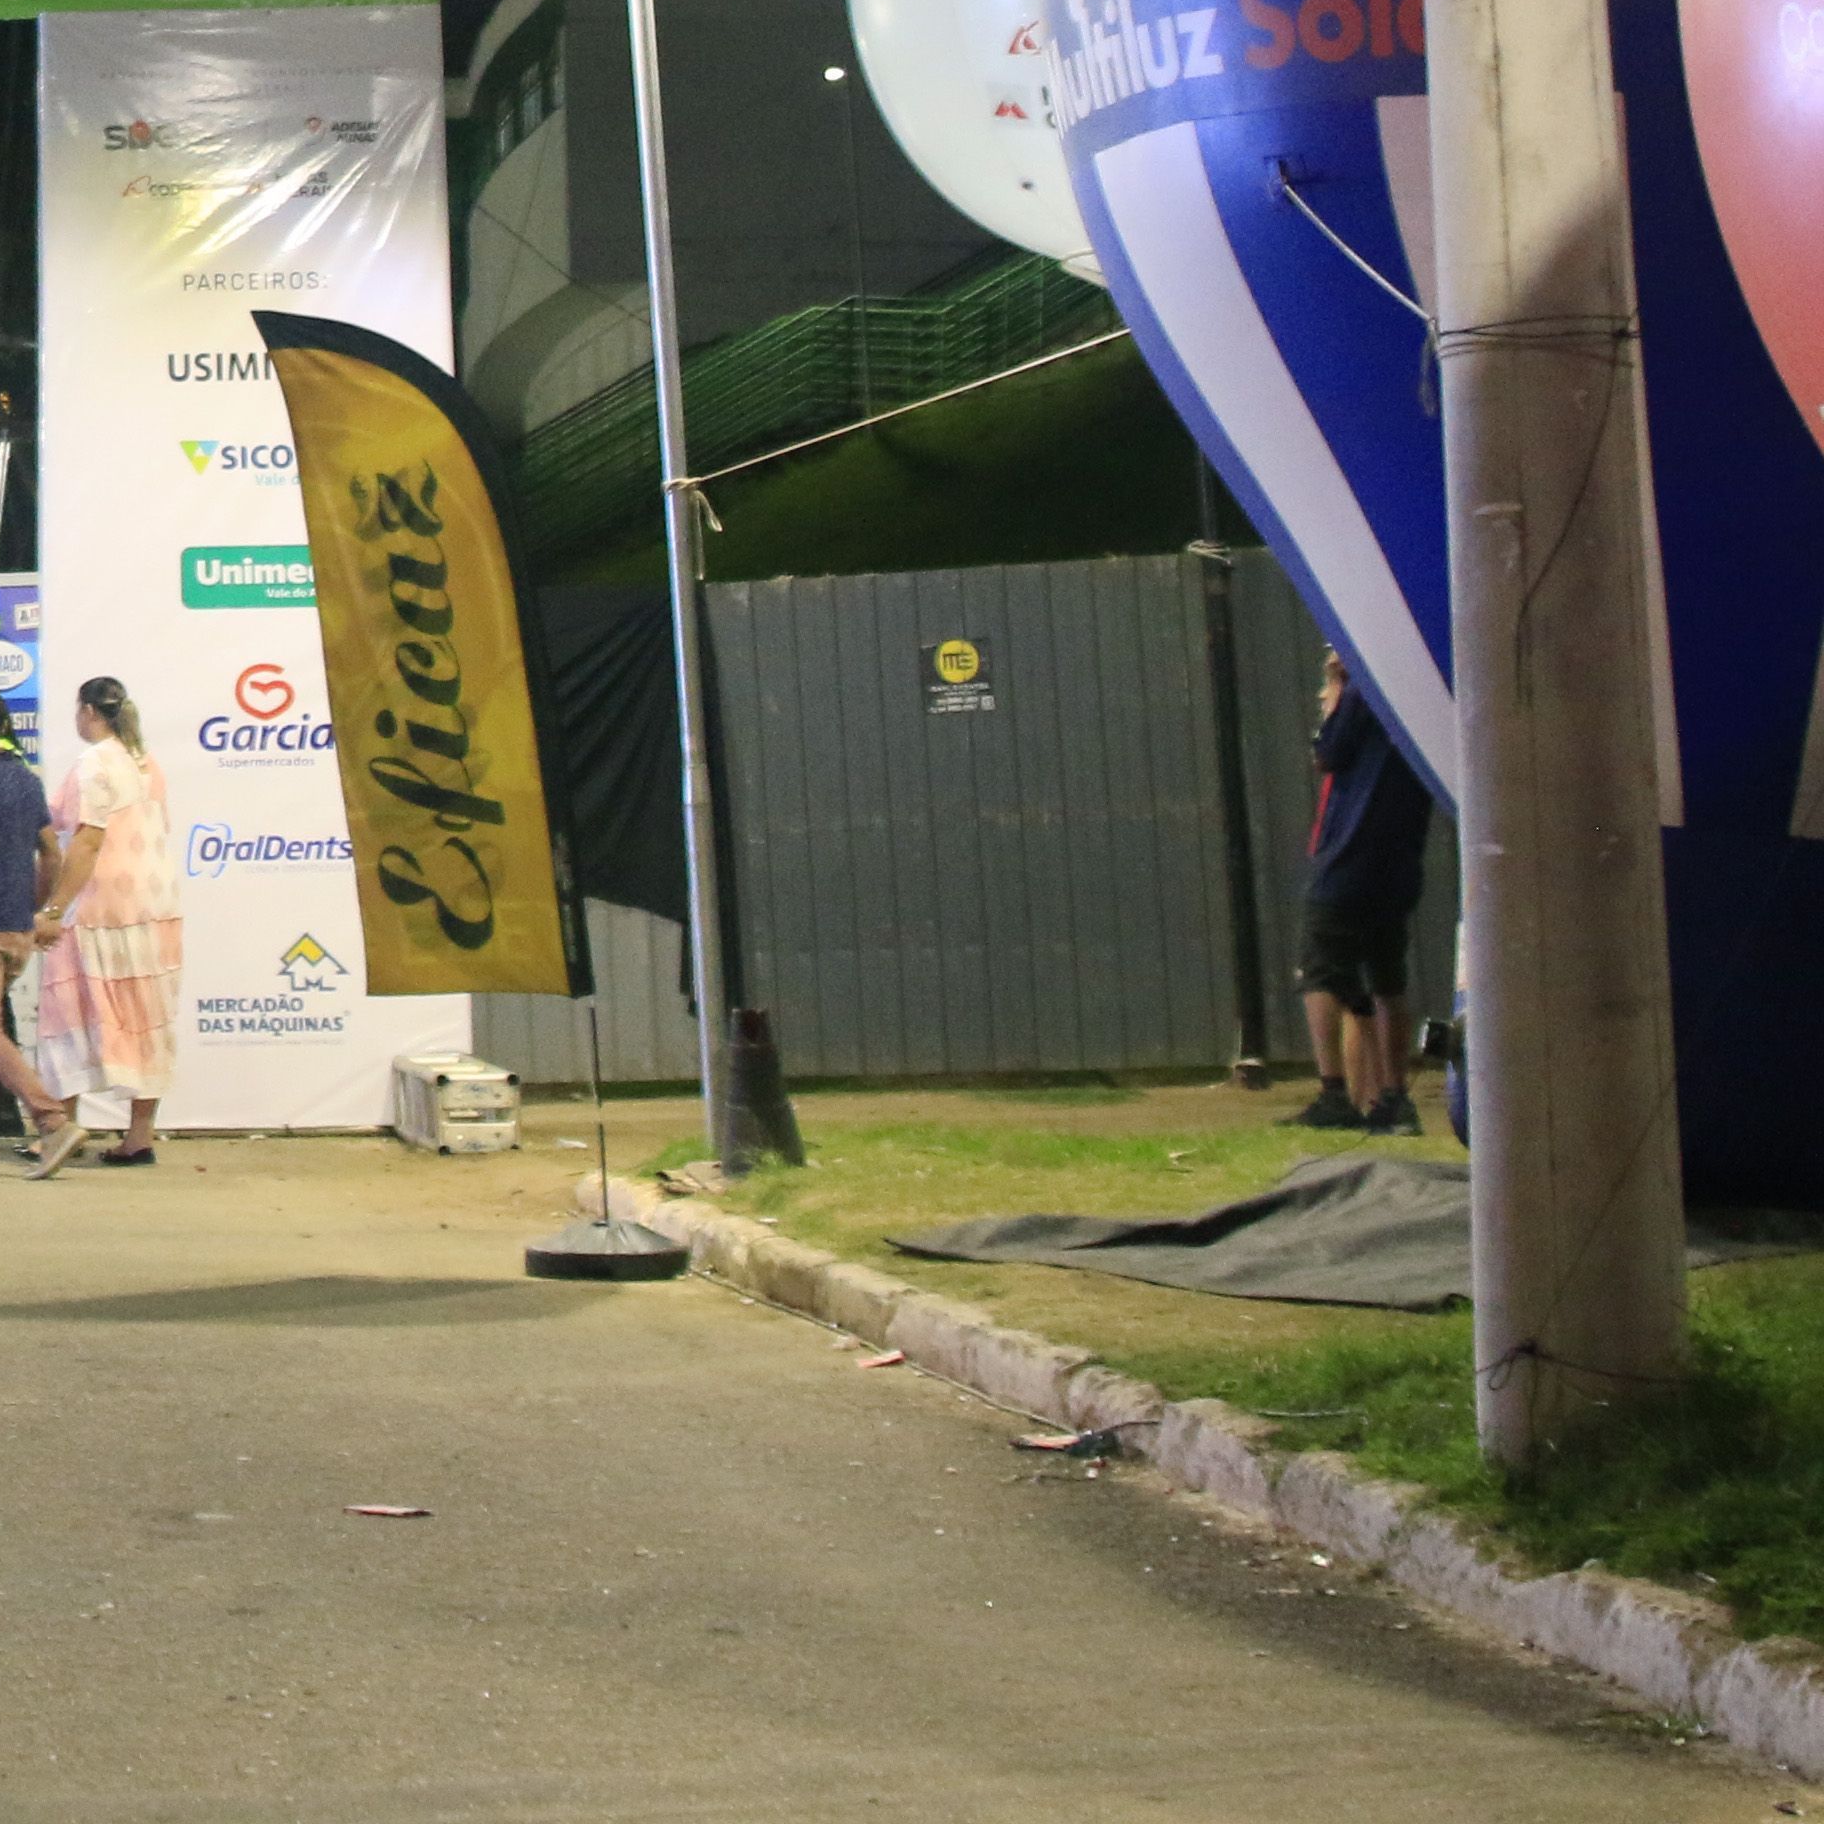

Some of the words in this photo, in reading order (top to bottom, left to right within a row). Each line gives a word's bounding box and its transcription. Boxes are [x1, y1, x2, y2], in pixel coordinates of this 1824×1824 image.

[182, 270, 328, 292] PARCEIROS:
[221, 444, 294, 470] SICO
[266, 586, 290, 598] Vale
[198, 712, 336, 752] Garcia
[217, 756, 316, 768] Supermercados
[200, 835, 355, 862] OralDents
[197, 993, 304, 1013] MERCADÃO
[198, 1018, 235, 1033] DAS
[239, 1013, 345, 1037] MÁQUINAS
